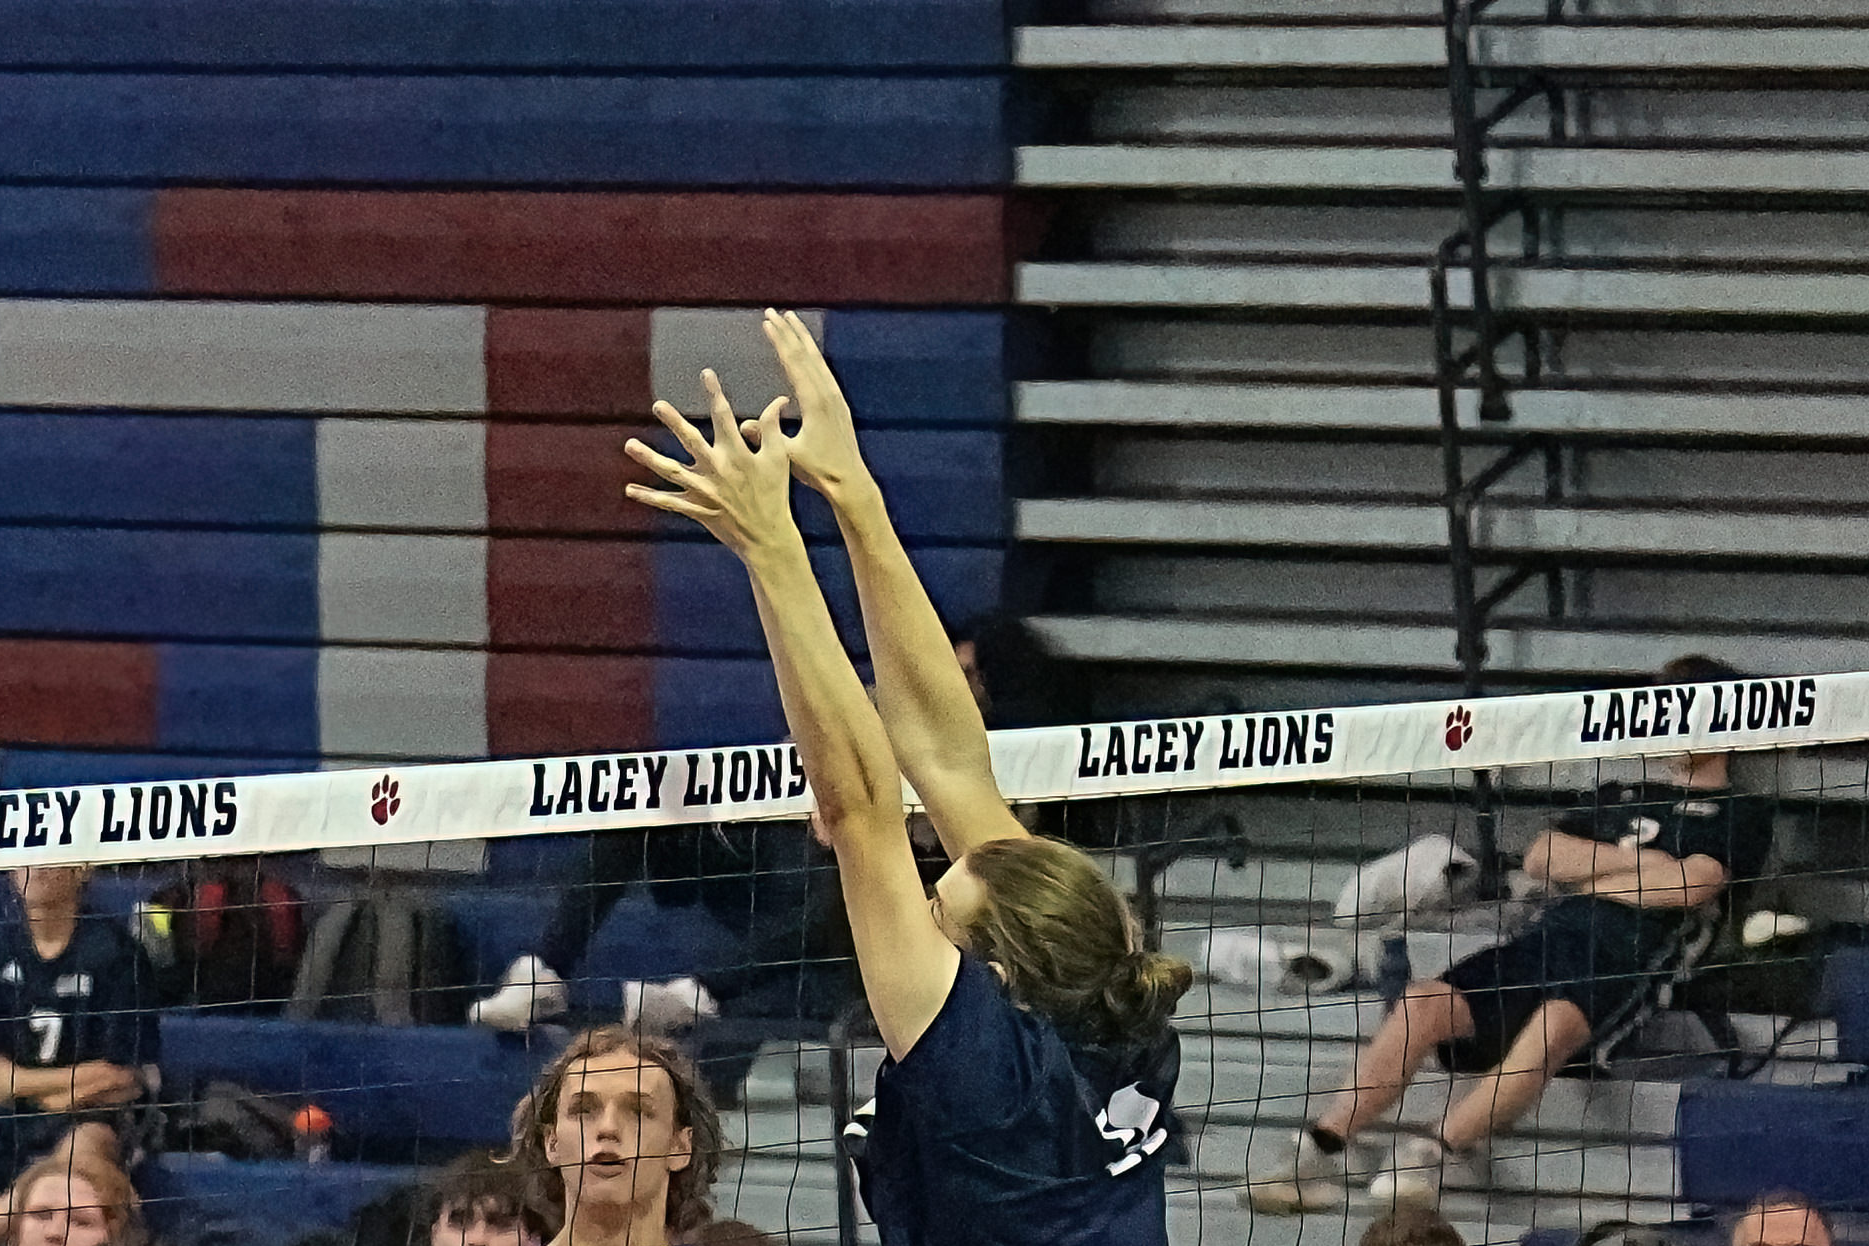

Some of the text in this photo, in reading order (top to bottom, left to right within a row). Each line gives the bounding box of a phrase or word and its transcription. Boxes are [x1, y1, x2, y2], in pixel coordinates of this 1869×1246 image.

[1581, 678, 1816, 742] LACEY LIONS
[1078, 713, 1334, 778] LACEY LIONS
[100, 782, 237, 843] LIONS
[530, 748, 807, 816] LACEY LIONS
[29, 1009, 62, 1063] 7
